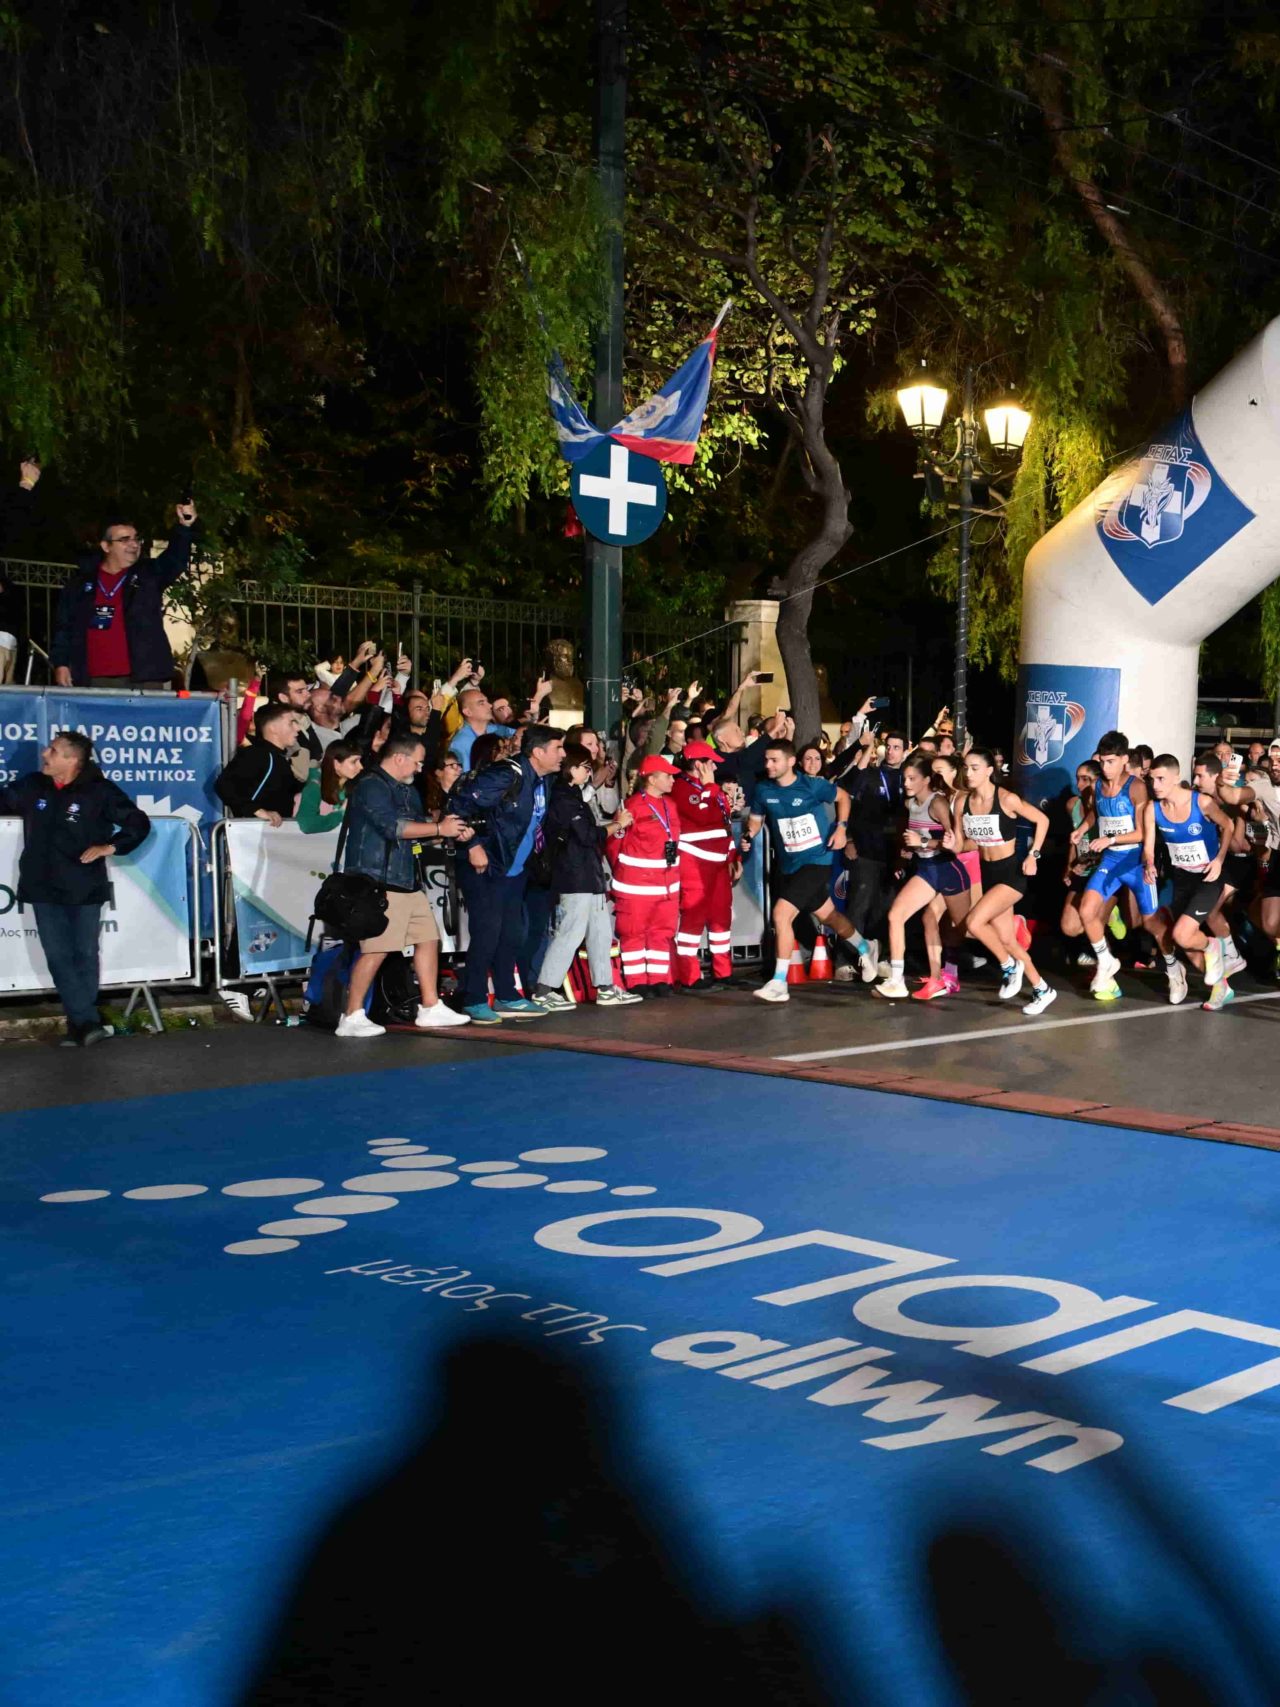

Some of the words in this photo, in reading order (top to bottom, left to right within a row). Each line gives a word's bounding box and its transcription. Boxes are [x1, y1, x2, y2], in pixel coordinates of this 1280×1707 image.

[102, 769, 196, 782] ΥΘΕΝΤΙΚΟΣ
[967, 827, 994, 836] 96208
[0, 928, 21, 938] λος
[24, 929, 37, 938] τη
[324, 1259, 533, 1312] μέλος
[521, 1302, 648, 1345] της
[651, 1330, 1125, 1474] allwyn
